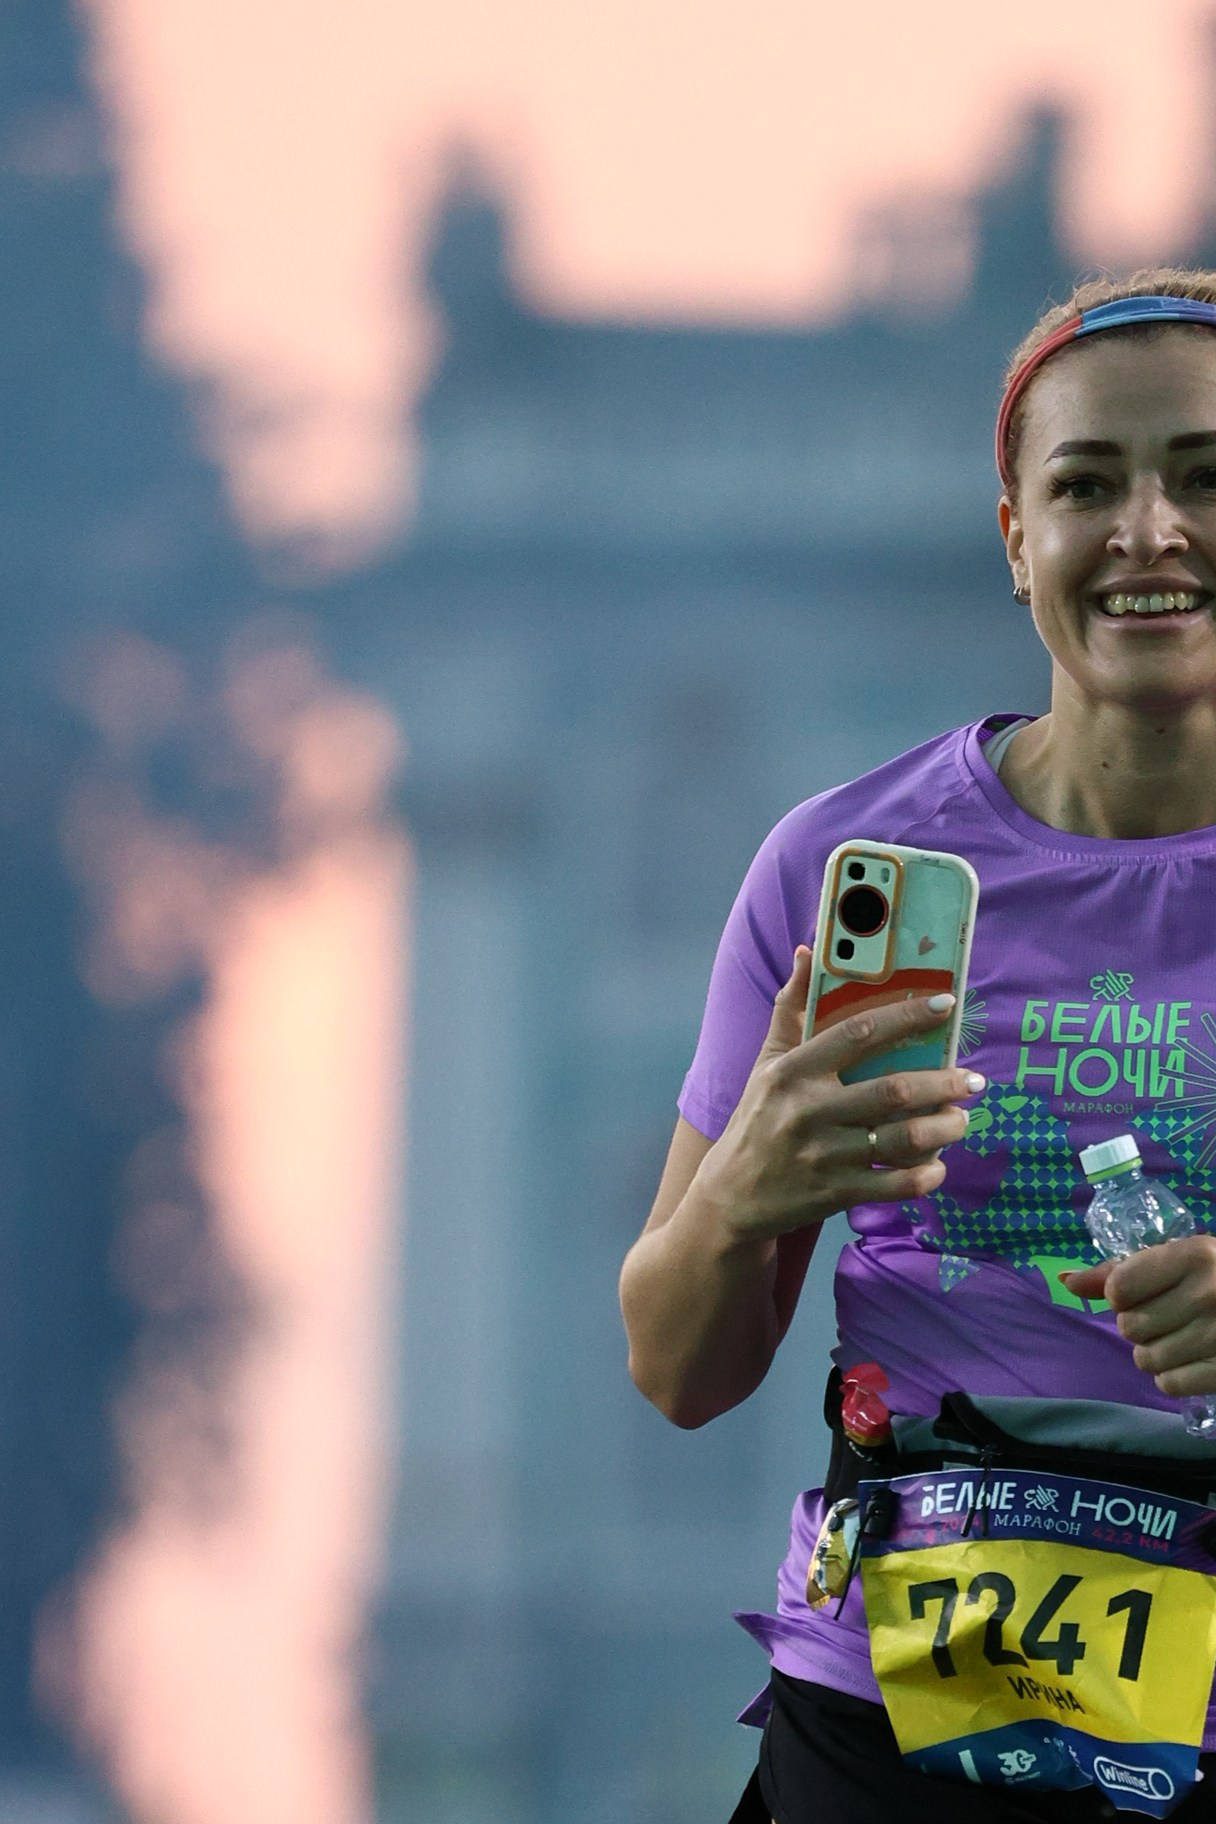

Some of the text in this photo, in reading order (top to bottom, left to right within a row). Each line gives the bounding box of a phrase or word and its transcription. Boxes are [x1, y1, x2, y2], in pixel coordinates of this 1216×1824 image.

[1020, 999, 1192, 1044] БЕЛЫЕ
[1015, 1046, 1187, 1098] НОЧИ
[1062, 1101, 1134, 1115] МАРАФОН
[920, 1481, 1178, 1541] БЕЛЫЕ НОЧИ
[993, 1513, 1082, 1536] МАРАФОН
[907, 1571, 1154, 1682] 7241
[1100, 1764, 1149, 1792] Winline
